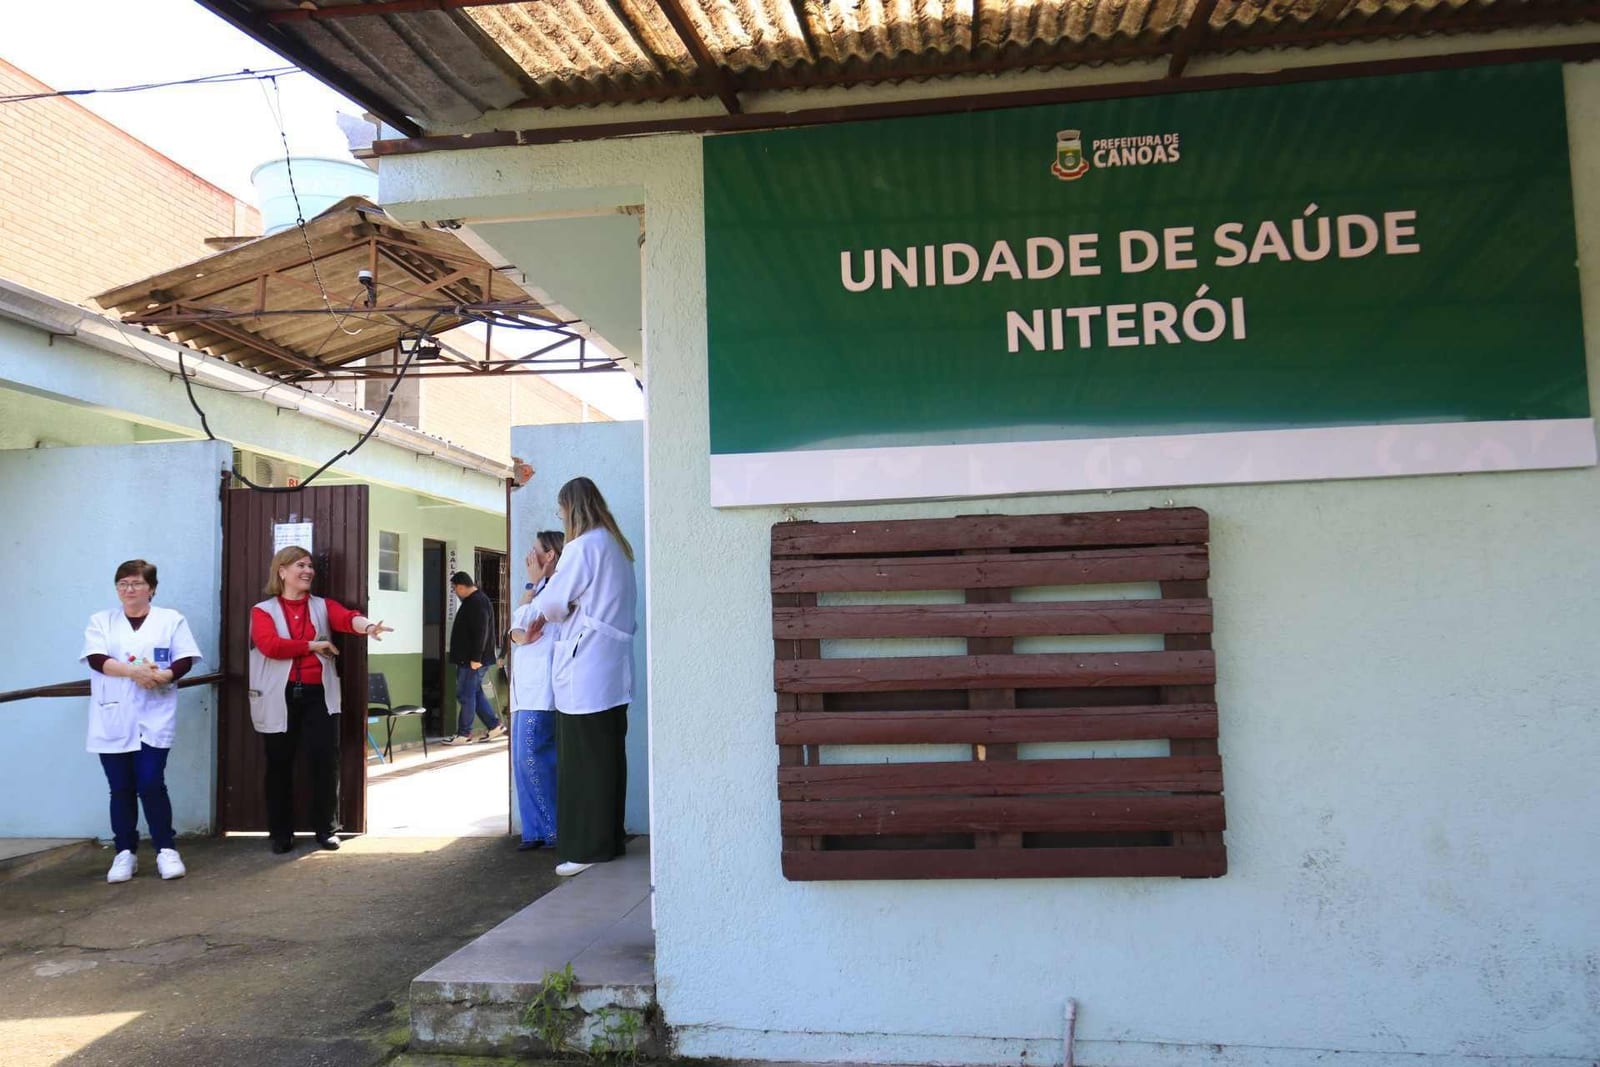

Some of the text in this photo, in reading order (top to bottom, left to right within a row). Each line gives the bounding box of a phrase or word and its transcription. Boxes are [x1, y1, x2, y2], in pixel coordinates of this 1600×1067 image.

[1093, 133, 1179, 150] PREFEITURA DE
[1093, 144, 1180, 168] CANOAS
[840, 203, 1420, 292] UNIDADE DE SAÚDE
[1006, 283, 1246, 353] NITERÓI
